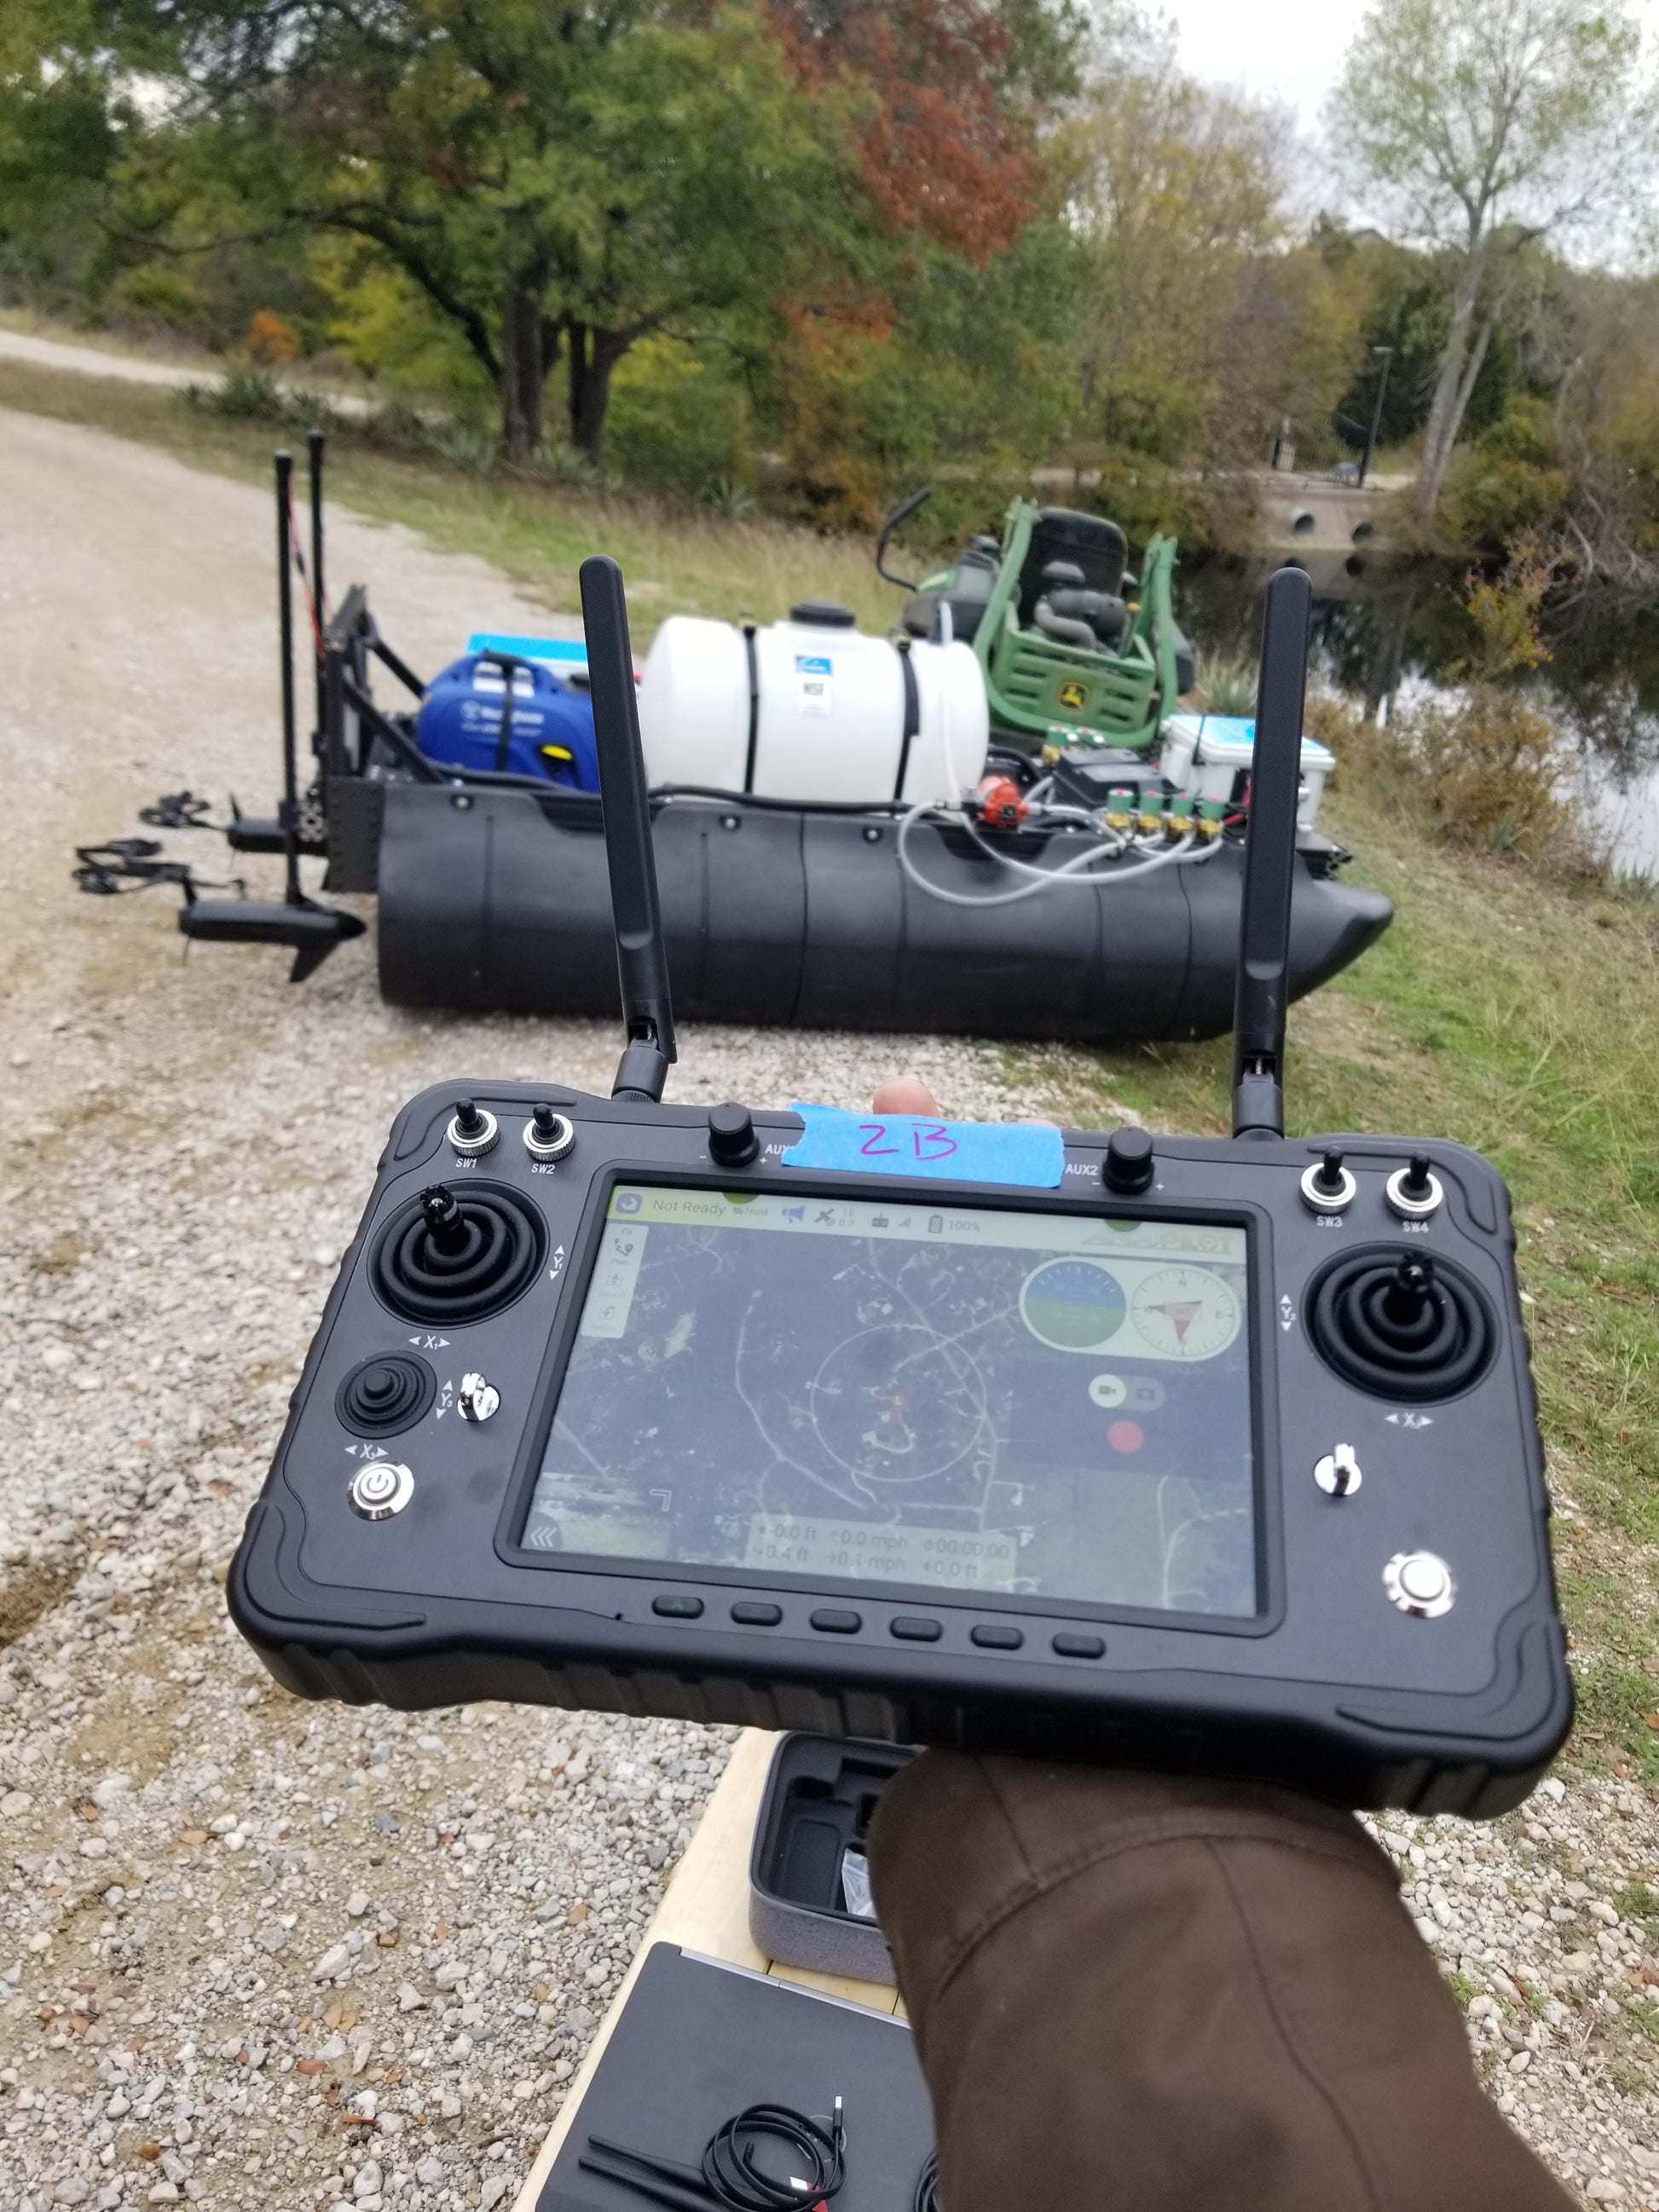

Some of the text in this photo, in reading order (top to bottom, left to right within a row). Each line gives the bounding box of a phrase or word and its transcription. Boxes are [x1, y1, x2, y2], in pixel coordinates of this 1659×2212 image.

[455, 1158, 477, 1170] SW1
[531, 1163, 556, 1175] SW2
[1065, 1163, 1099, 1176] AUX2
[652, 1199, 679, 1212] Not
[682, 1201, 726, 1217] Ready
[948, 1220, 981, 1232] 100%
[1315, 1215, 1344, 1228] SW3
[1402, 1220, 1430, 1233] SW4
[803, 1525, 818, 1542] ft
[870, 1533, 908, 1550] mph
[796, 1545, 810, 1562] ft
[867, 1553, 906, 1572] mph
[965, 1562, 978, 1579] ft
